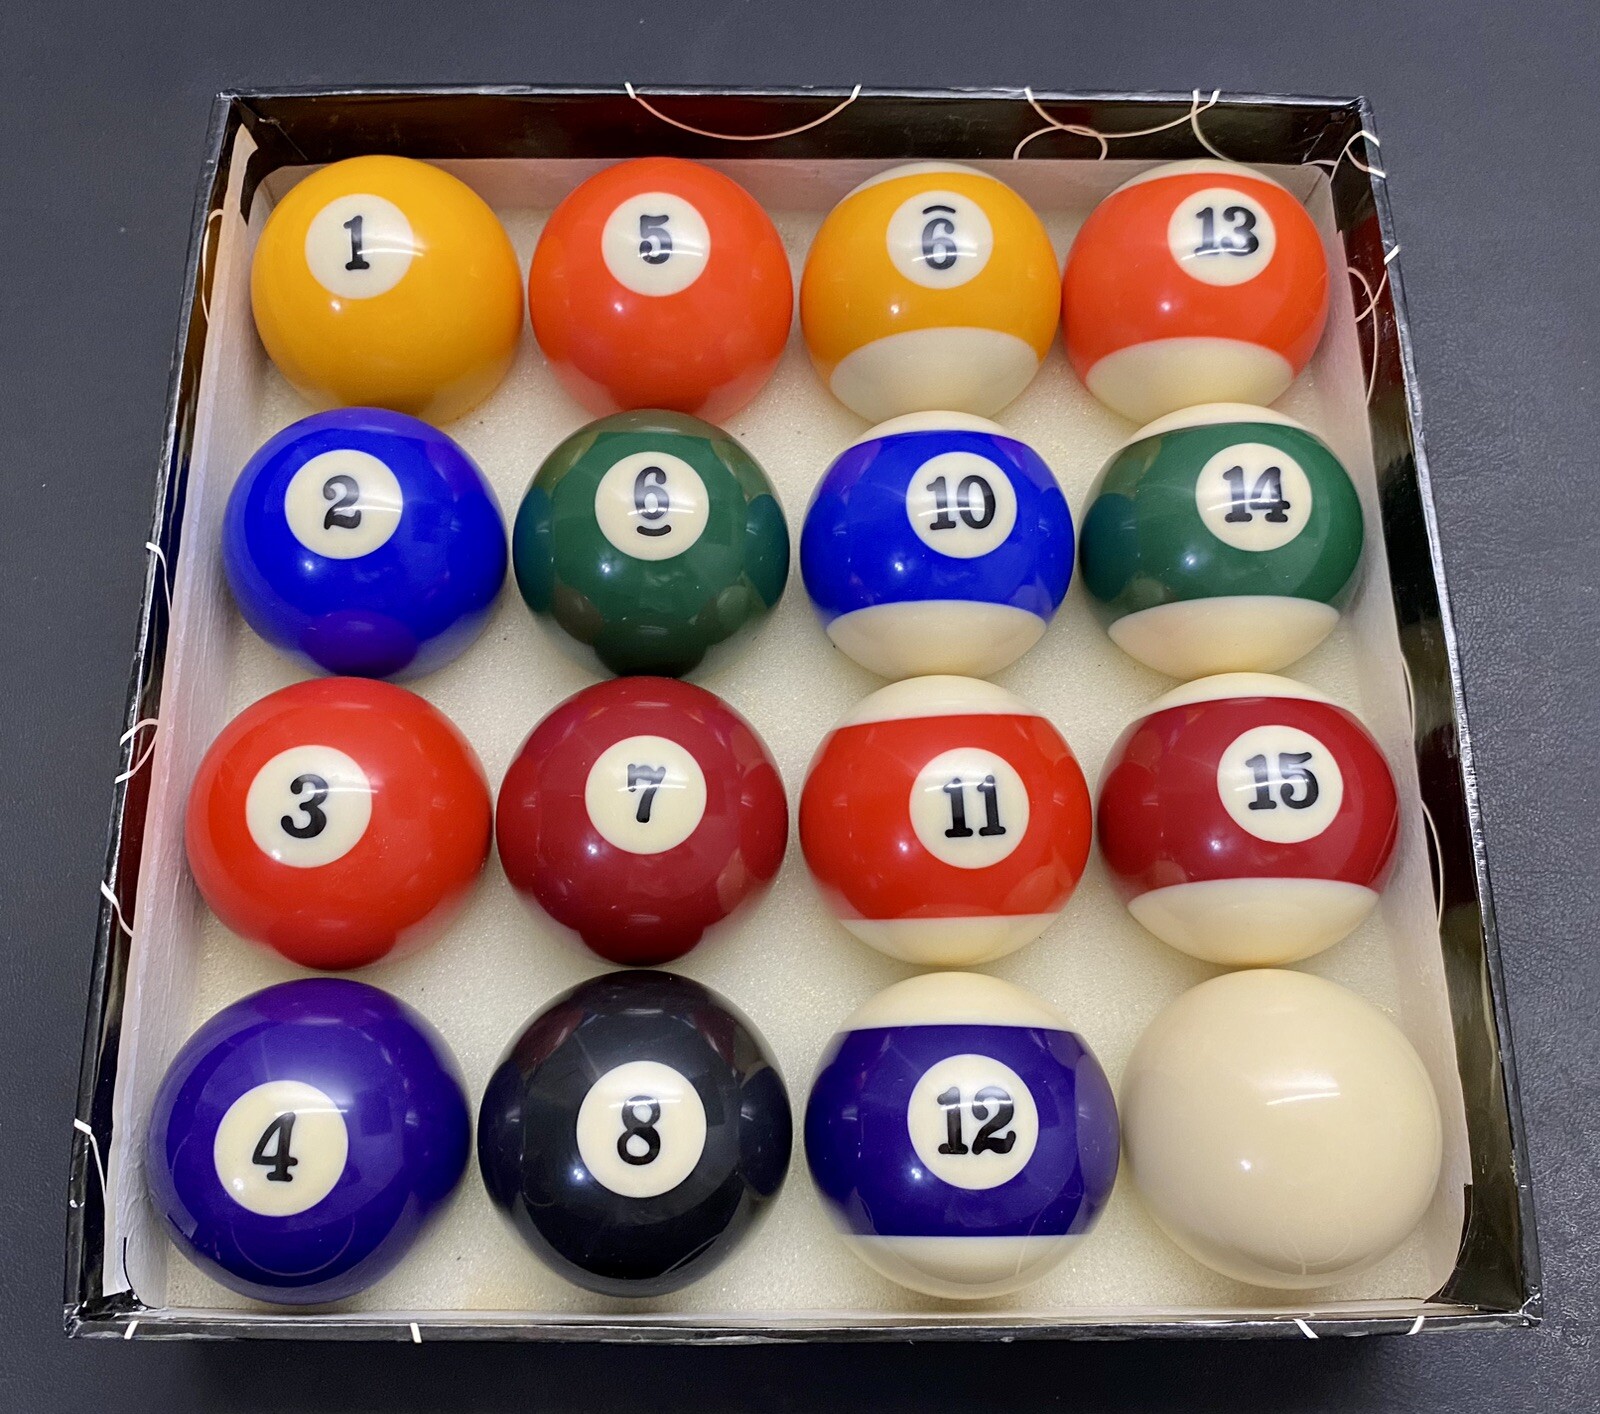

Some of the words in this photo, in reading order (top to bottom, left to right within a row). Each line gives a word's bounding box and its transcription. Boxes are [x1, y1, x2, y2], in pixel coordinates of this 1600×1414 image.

[344, 214, 371, 272] 1
[638, 214, 673, 265] 5
[1194, 205, 1259, 257] 13
[322, 474, 362, 531] 2
[634, 465, 672, 537] 6
[926, 474, 997, 531] 10
[1222, 465, 1292, 524] 14
[280, 774, 329, 840] 3
[627, 763, 667, 824] 7
[942, 774, 1007, 839] 11
[1245, 751, 1320, 811] 15
[251, 1111, 299, 1183] 4
[616, 1095, 662, 1167] 8
[936, 1086, 1017, 1156] 12
